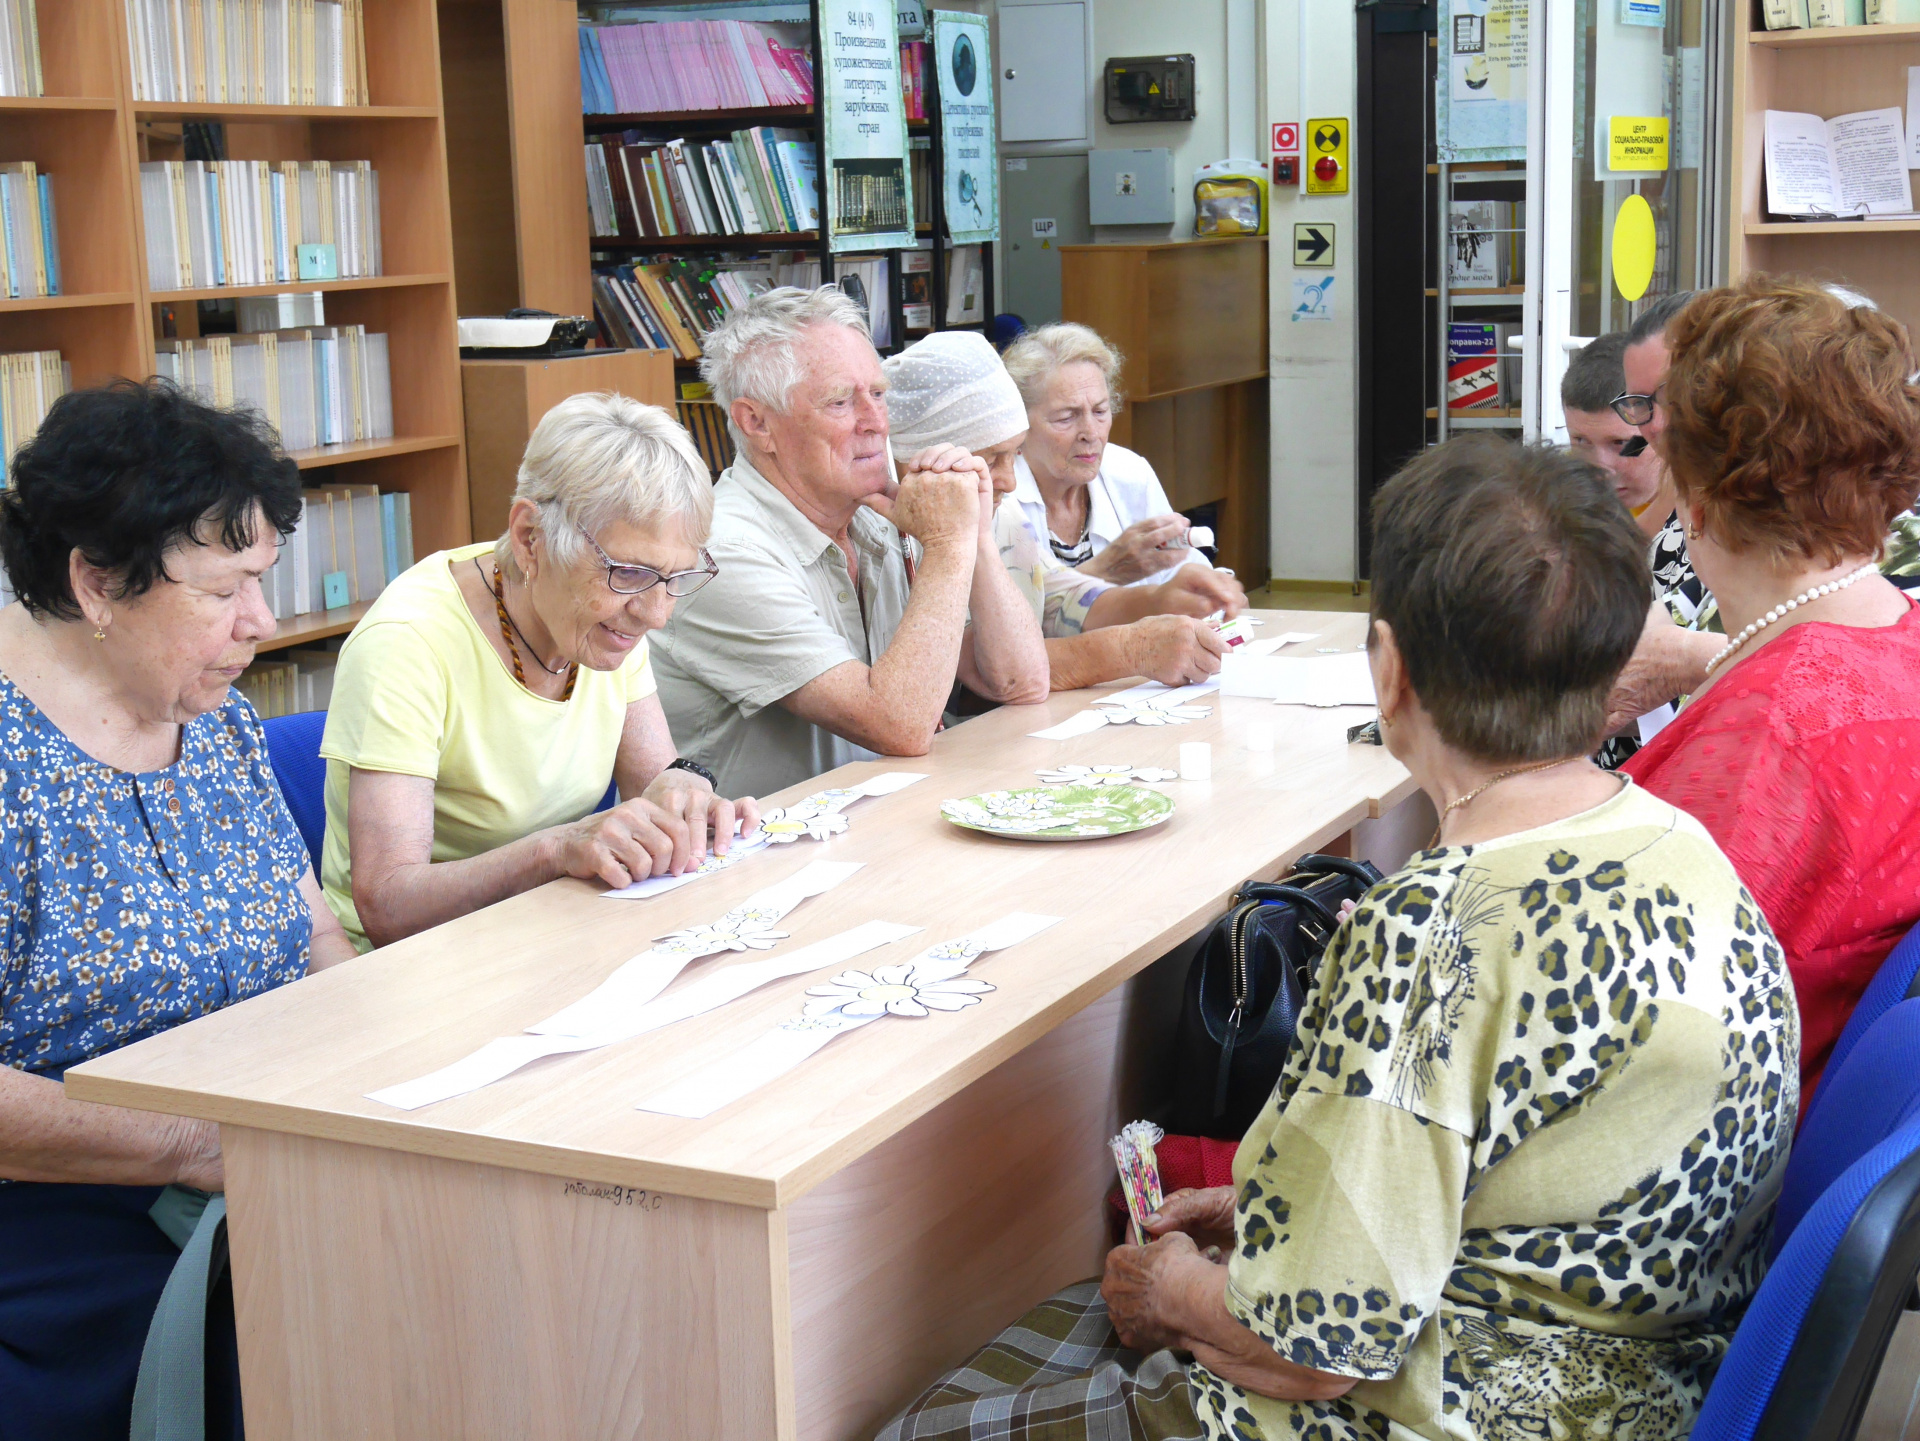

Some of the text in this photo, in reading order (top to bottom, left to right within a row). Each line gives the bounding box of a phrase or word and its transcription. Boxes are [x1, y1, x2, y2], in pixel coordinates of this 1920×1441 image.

[847, 11, 874, 30] 84 (4/8)
[834, 32, 887, 51] Произведения
[833, 58, 893, 72] художественной
[844, 79, 887, 94] литературы
[844, 96, 889, 116] зарубежных
[858, 123, 880, 137] стран
[1632, 126, 1647, 134] ЦЕНТР
[1614, 135, 1664, 144] СОЦИАЛЬНО-ПРАВОВОЙ
[1624, 146, 1654, 154] ИНФОРМАЦИИ
[1035, 221, 1053, 233] ЩР
[309, 255, 318, 265] М
[1448, 273, 1470, 283] ердце
[1449, 338, 1494, 348] оправка-22
